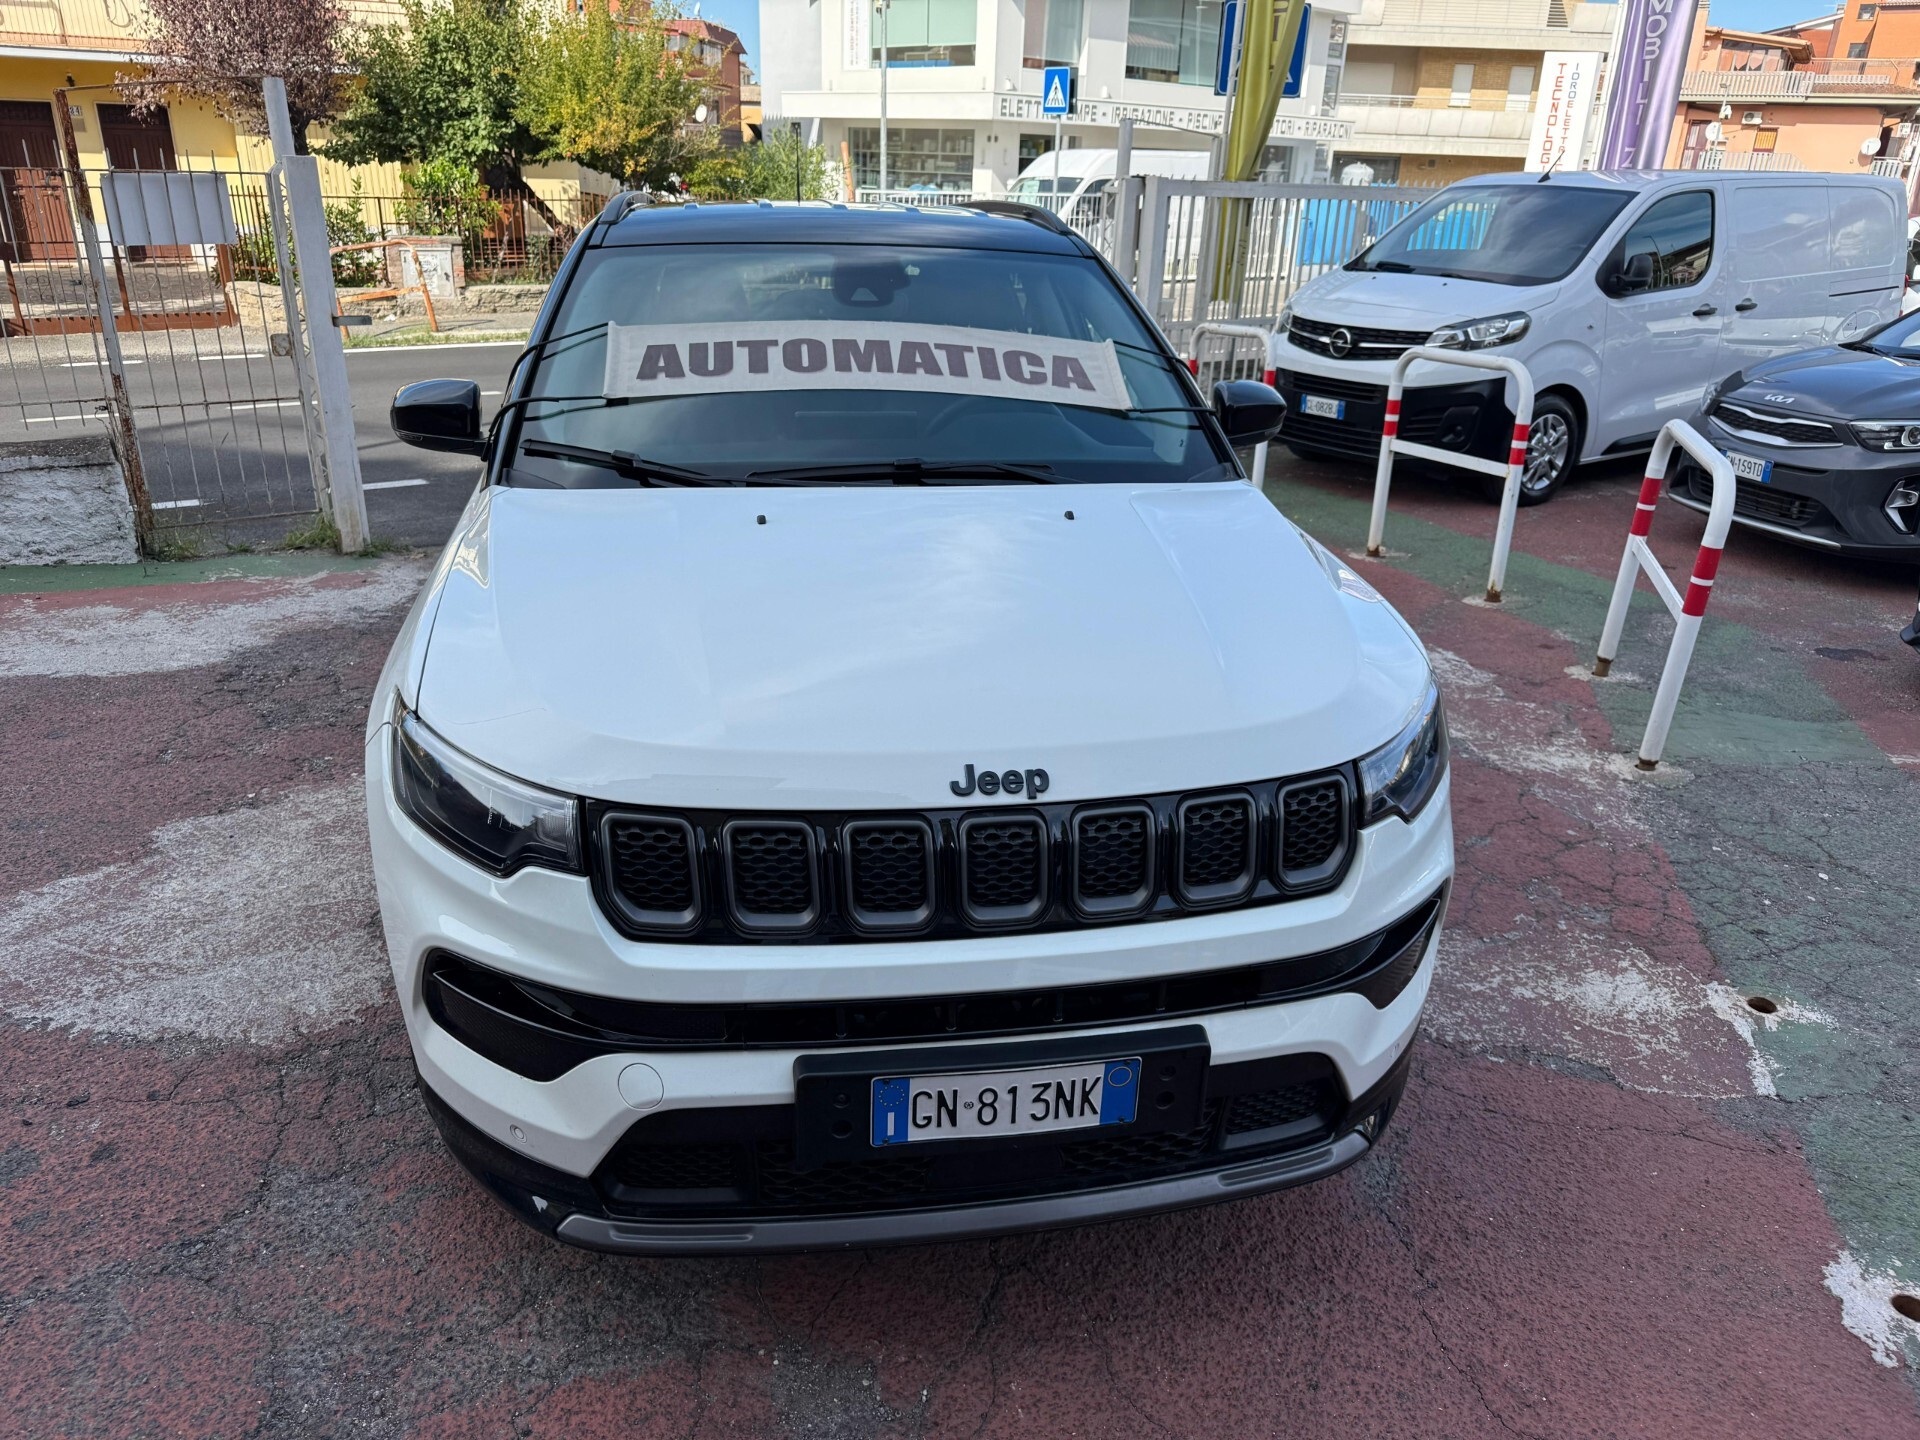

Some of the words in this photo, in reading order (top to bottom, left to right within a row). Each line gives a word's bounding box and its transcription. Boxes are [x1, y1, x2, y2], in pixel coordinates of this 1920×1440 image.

[1111, 105, 1176, 127] IRRIGAZIONE
[635, 337, 1097, 392] AUTOMATICA
[949, 763, 1050, 800] Jeep
